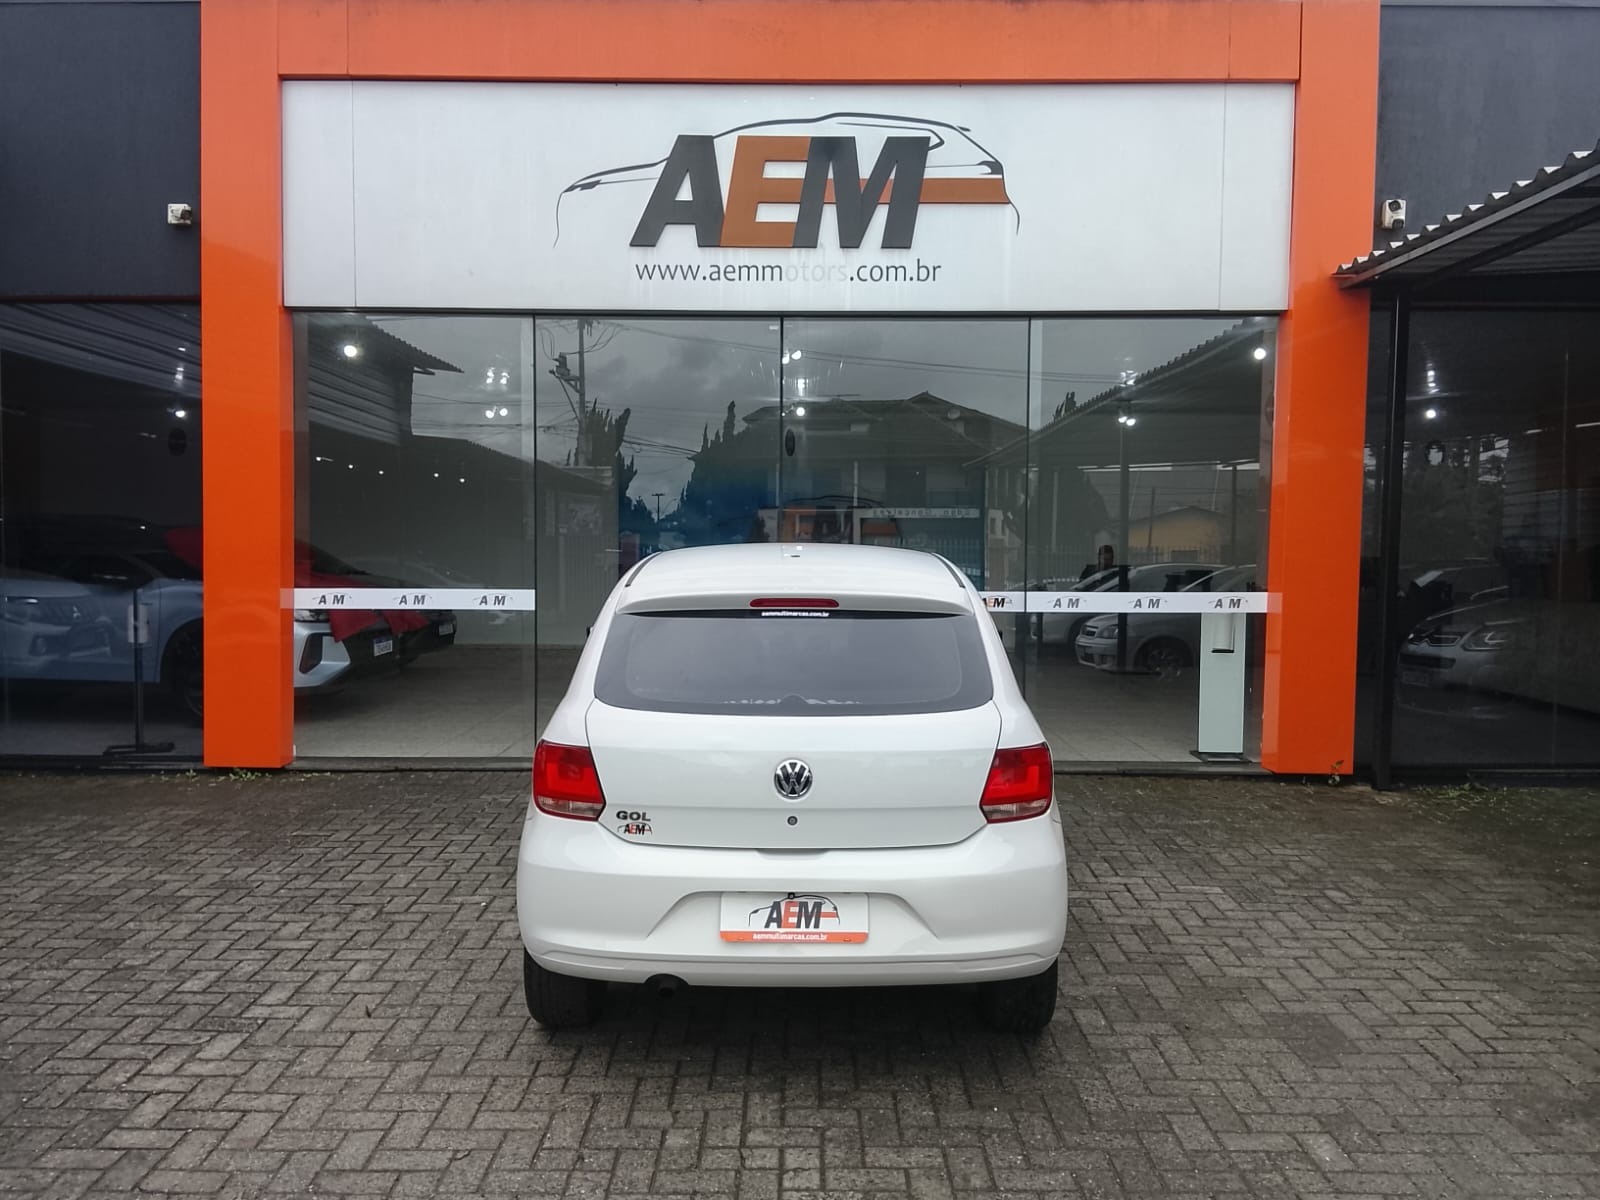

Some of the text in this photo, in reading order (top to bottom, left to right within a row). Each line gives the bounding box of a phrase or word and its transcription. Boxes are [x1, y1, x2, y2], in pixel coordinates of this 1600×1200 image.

[629, 134, 931, 249] AEM
[616, 810, 651, 821] GOL
[624, 823, 646, 835] AEM
[765, 901, 823, 929] AEM
